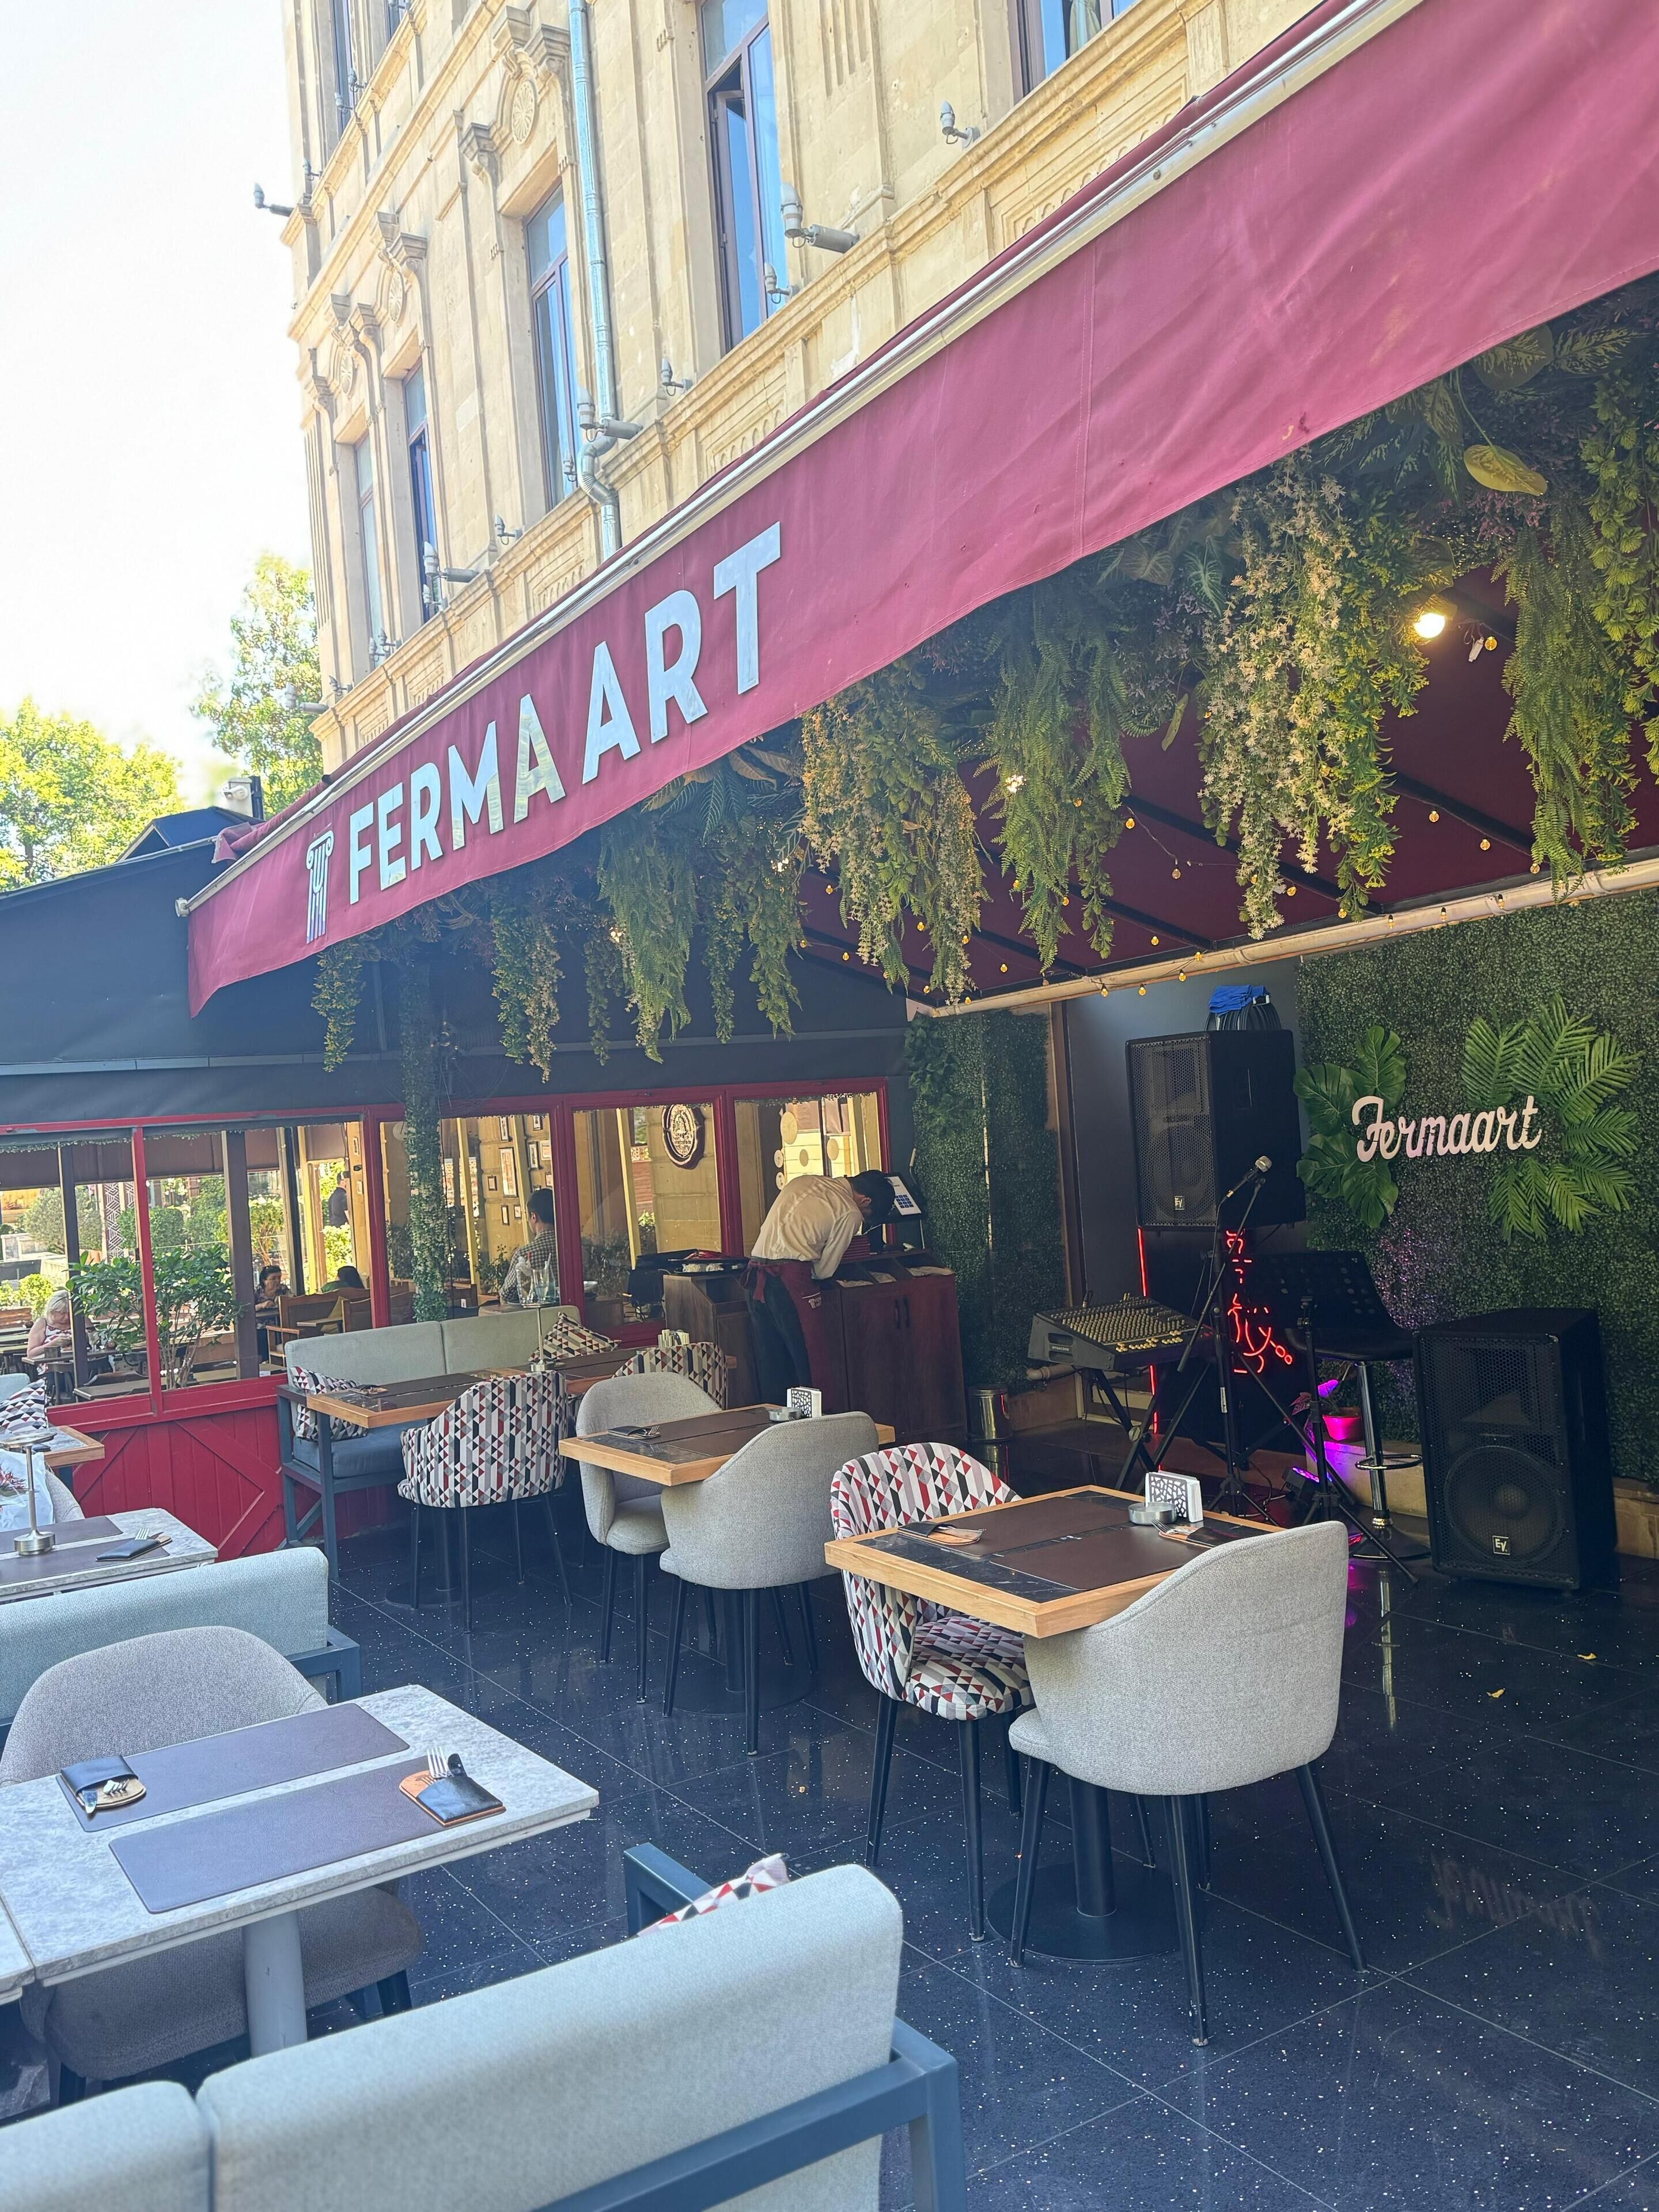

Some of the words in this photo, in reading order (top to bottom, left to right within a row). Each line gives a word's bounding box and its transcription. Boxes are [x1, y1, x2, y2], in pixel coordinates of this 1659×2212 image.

[349, 693, 566, 905] FERMA
[582, 521, 781, 785] ART
[1351, 1095, 1542, 1162] Fermaart
[1495, 1538, 1506, 1552] EV
